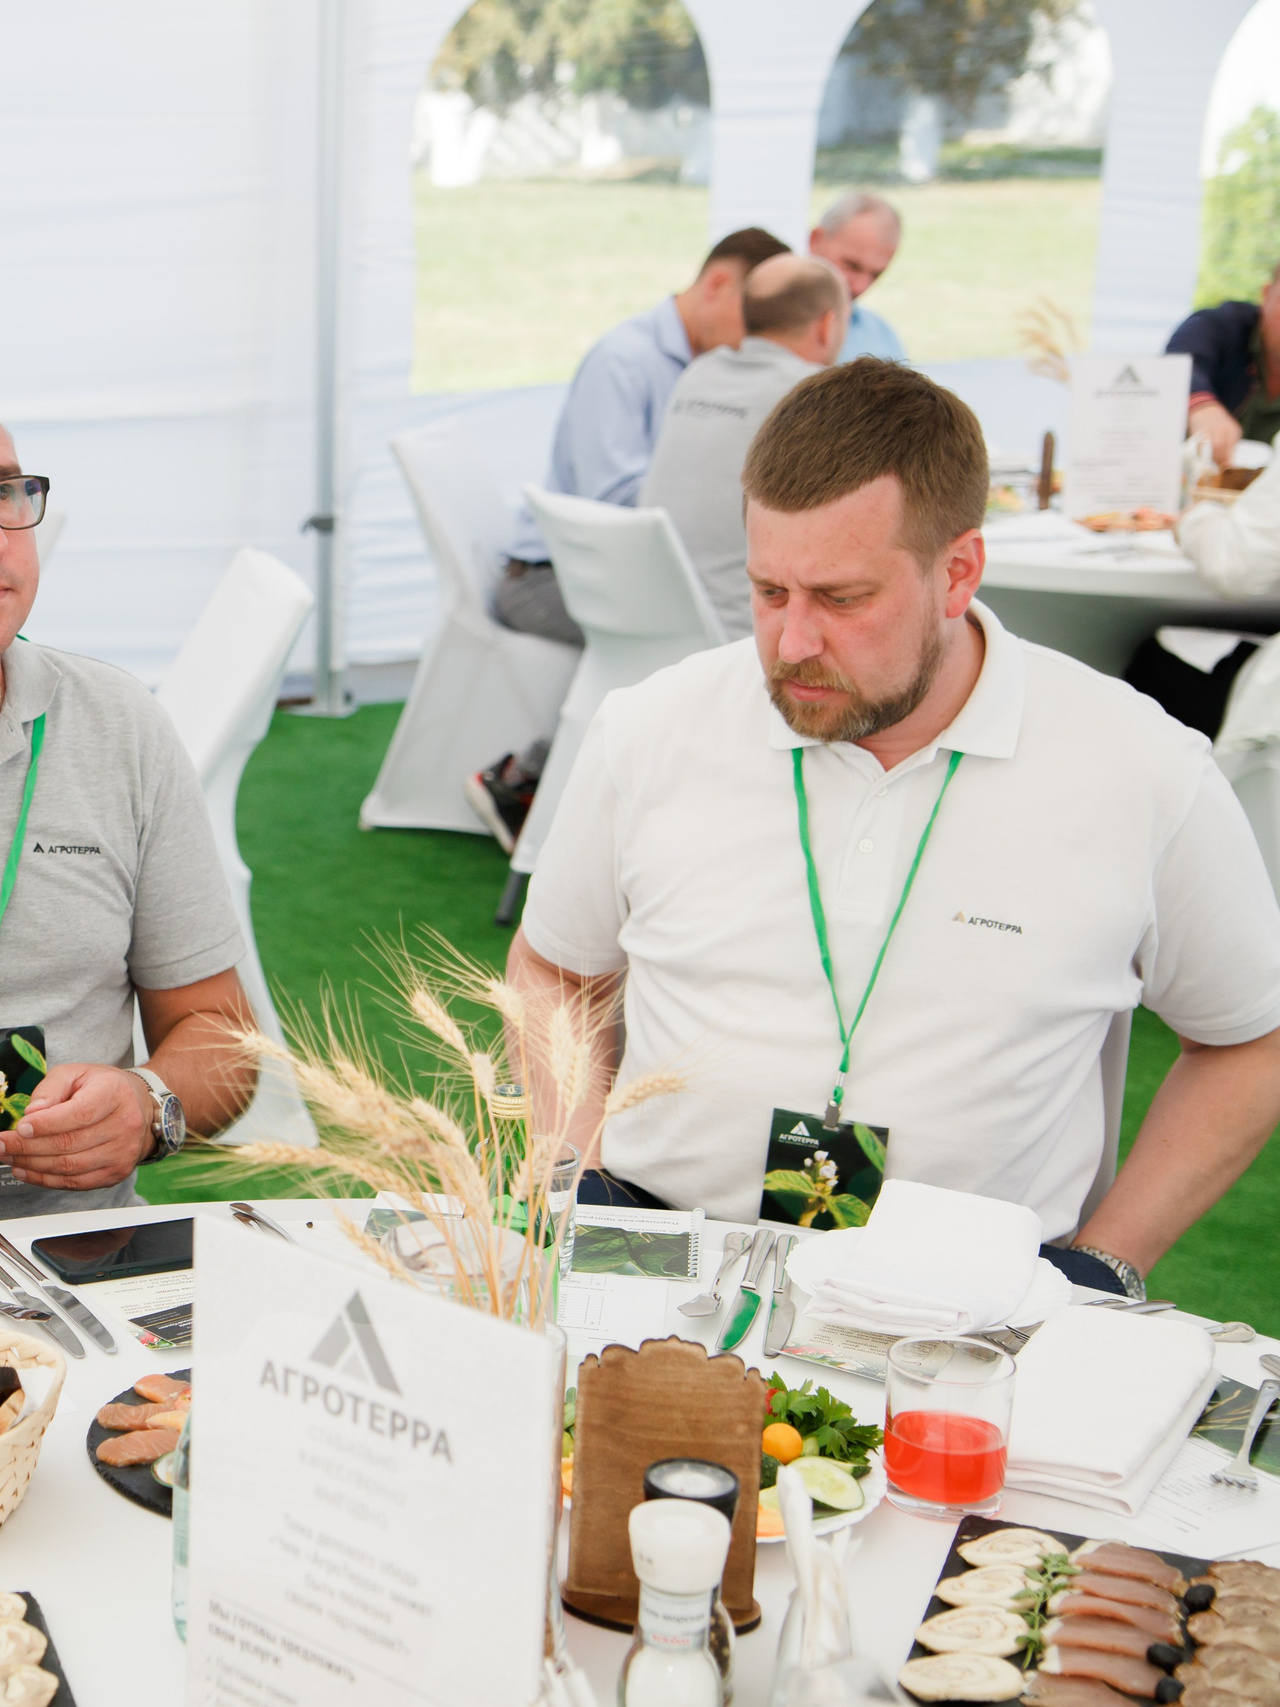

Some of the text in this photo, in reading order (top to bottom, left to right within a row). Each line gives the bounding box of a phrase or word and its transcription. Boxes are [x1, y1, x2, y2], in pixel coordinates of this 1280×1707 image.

[47, 845, 101, 855] АГРОТЕРРА
[967, 916, 1023, 935] АГРОТЕРРА
[778, 1133, 820, 1147] АГРОТЕРРА
[258, 1360, 454, 1465] АГРОТЕРРА
